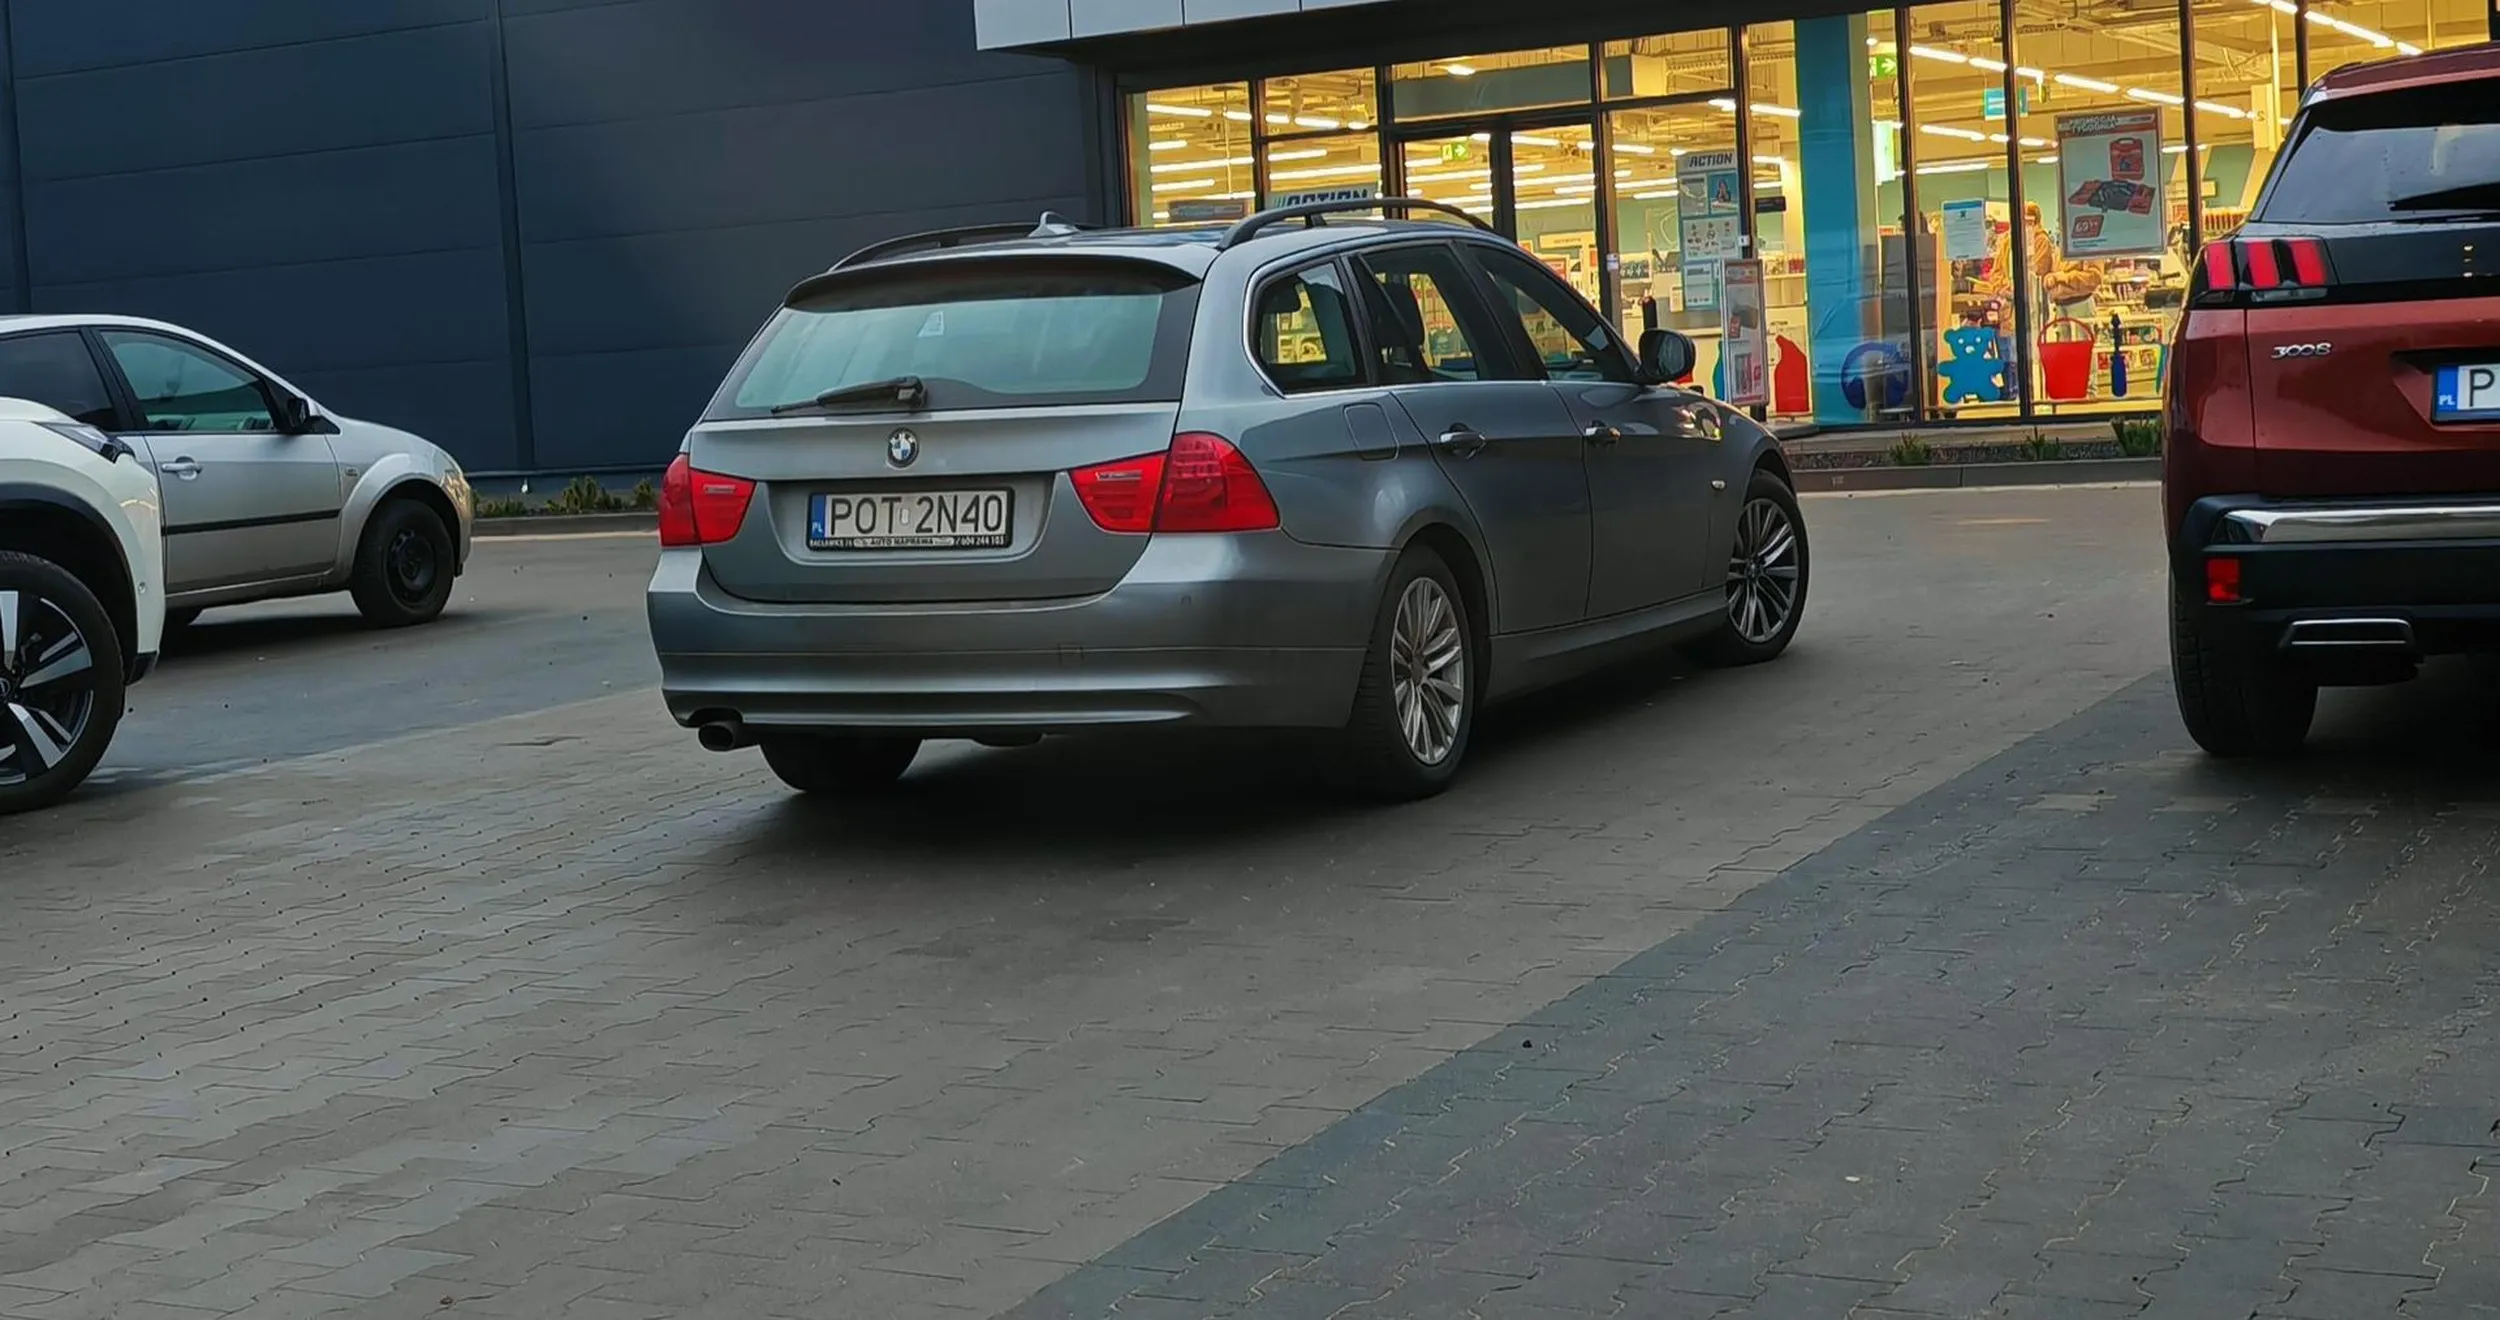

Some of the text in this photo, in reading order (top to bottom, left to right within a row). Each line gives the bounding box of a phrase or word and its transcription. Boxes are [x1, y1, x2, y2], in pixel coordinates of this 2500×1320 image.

[1689, 153, 1732, 167] ACTION
[2468, 368, 2495, 407] P
[2438, 394, 2456, 406] PL
[831, 494, 1002, 536] POT 2N40
[812, 522, 823, 533] PL
